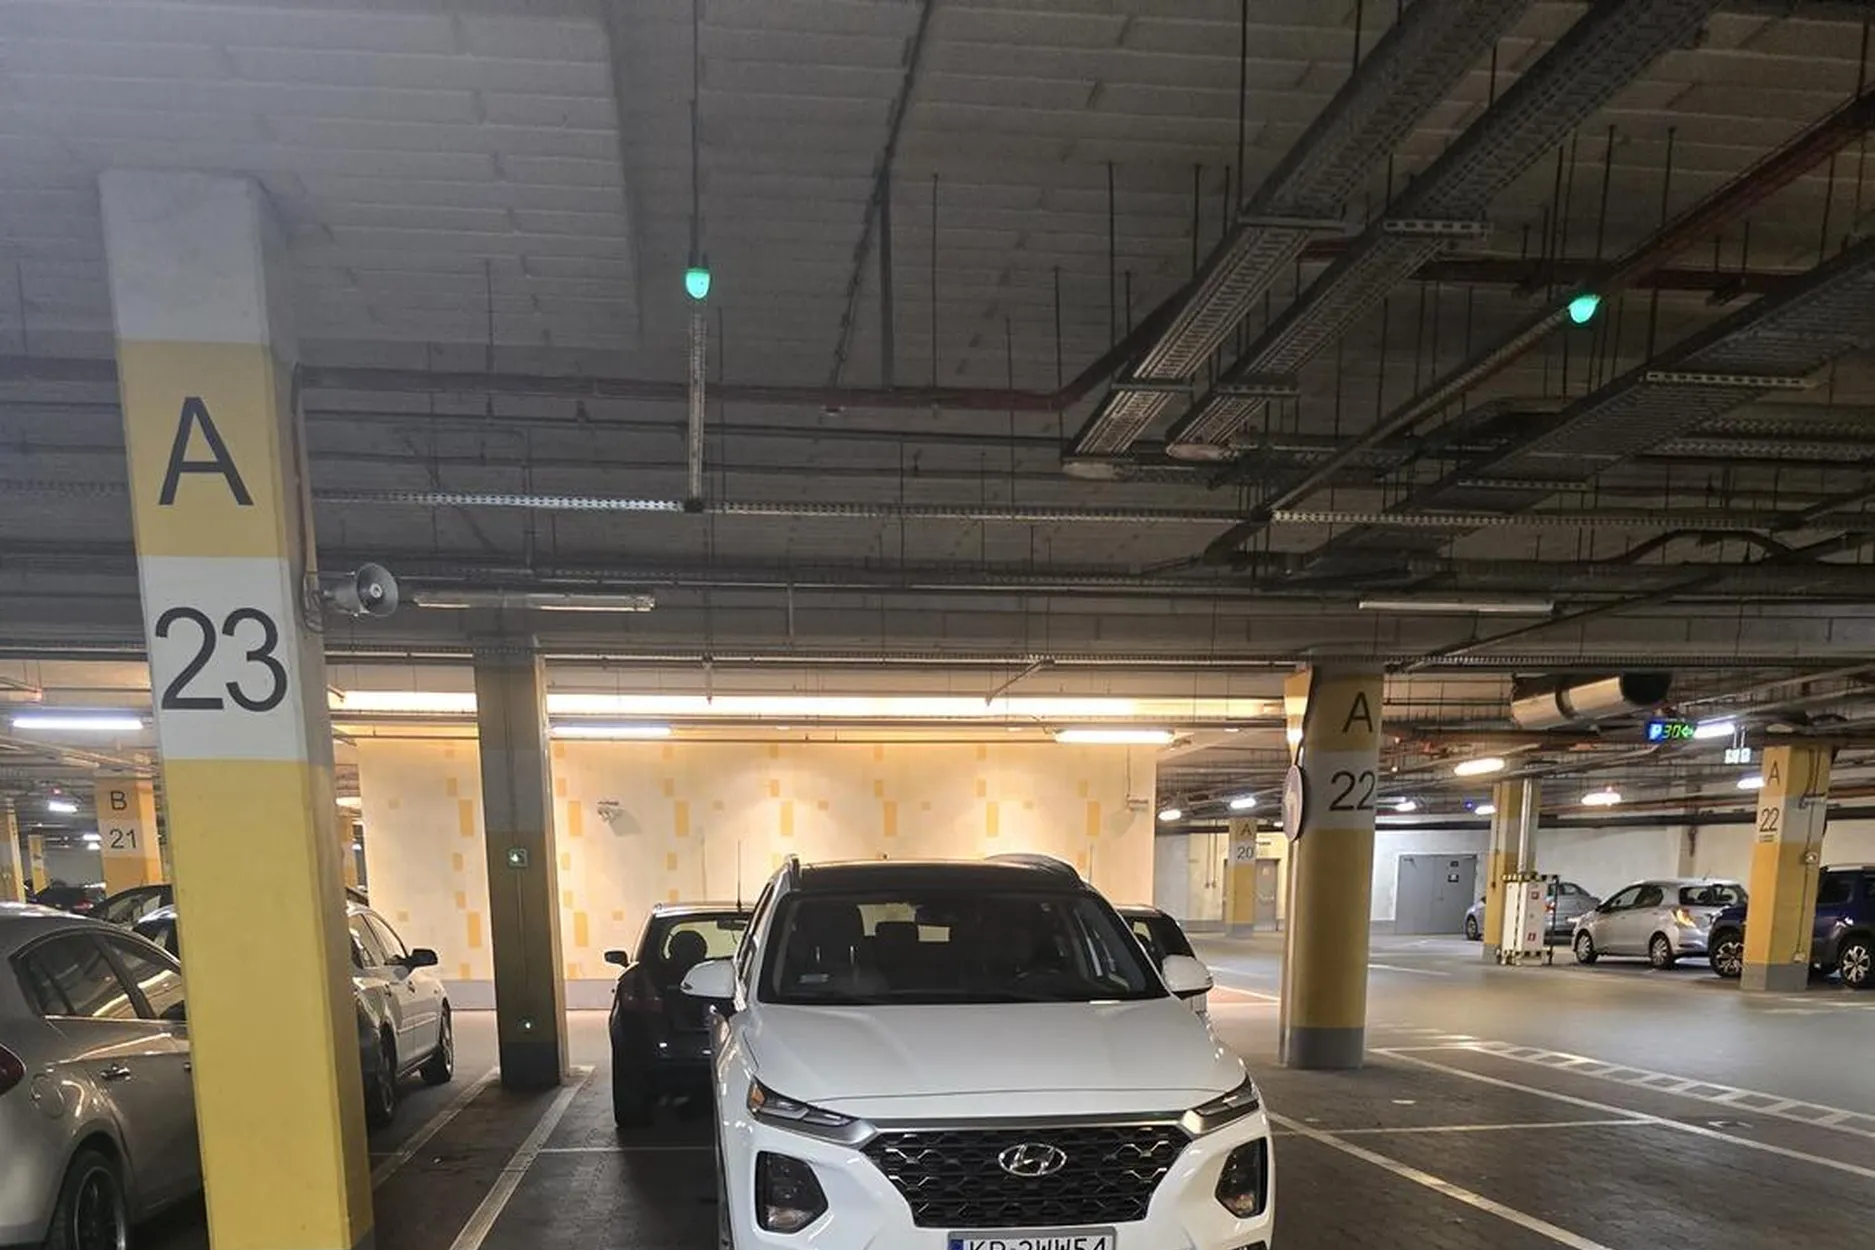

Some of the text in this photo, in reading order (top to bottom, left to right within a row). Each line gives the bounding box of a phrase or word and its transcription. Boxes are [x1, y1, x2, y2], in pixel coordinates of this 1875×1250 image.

[158, 396, 254, 506] A
[155, 606, 288, 713] 23
[1341, 691, 1374, 734] A
[1766, 760, 1781, 787] A
[110, 790, 128, 811] B
[1328, 770, 1376, 812] 22
[1240, 822, 1253, 836] A
[1759, 807, 1780, 832] 22
[109, 827, 137, 849] 21
[1236, 846, 1255, 860] 20
